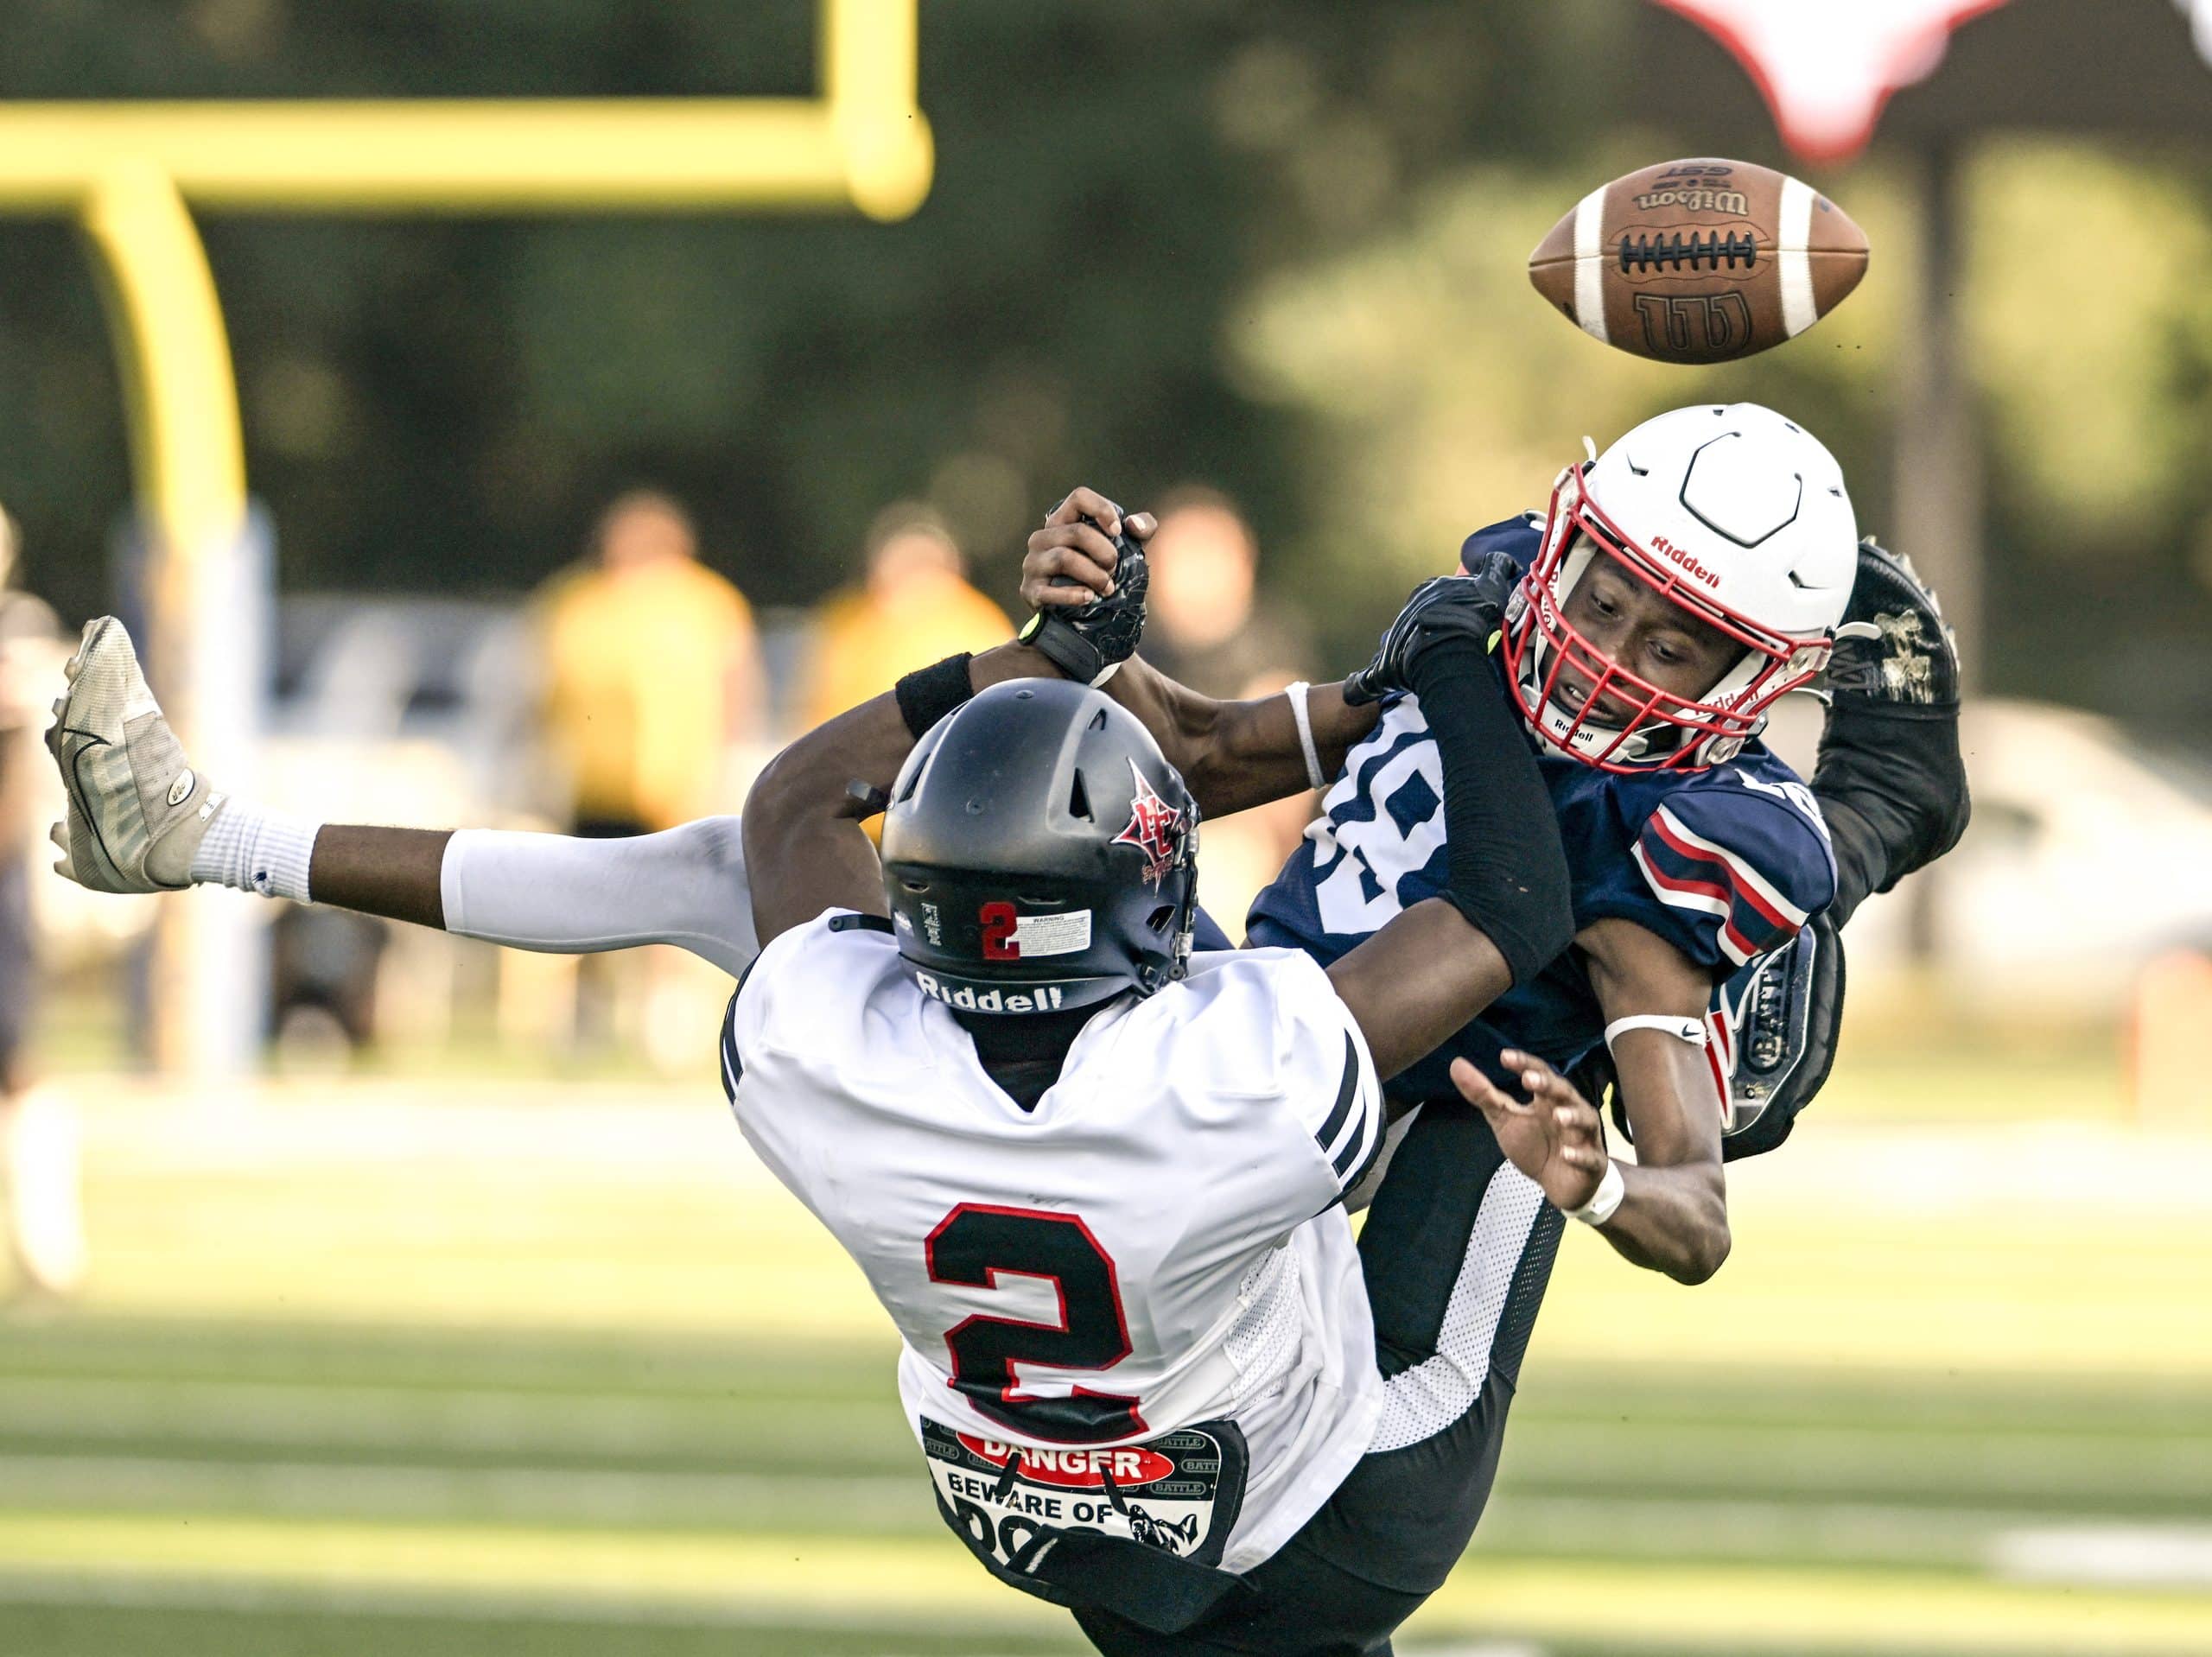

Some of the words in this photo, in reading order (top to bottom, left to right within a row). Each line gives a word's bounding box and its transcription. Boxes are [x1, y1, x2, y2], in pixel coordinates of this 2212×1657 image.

[1631, 189, 1750, 216] Wilson
[1650, 536, 1719, 588] Riddell
[980, 901, 1020, 961] 2
[916, 971, 1062, 1013] Riddell
[924, 1202, 1150, 1444] 2
[925, 1441, 956, 1458] ATTLE
[983, 1440, 1142, 1478] DANGER
[1186, 1461, 1218, 1470] BATT
[948, 1472, 1062, 1519] BEWARE
[1072, 1501, 1113, 1524] OF
[1155, 1484, 1201, 1493] BATTLE
